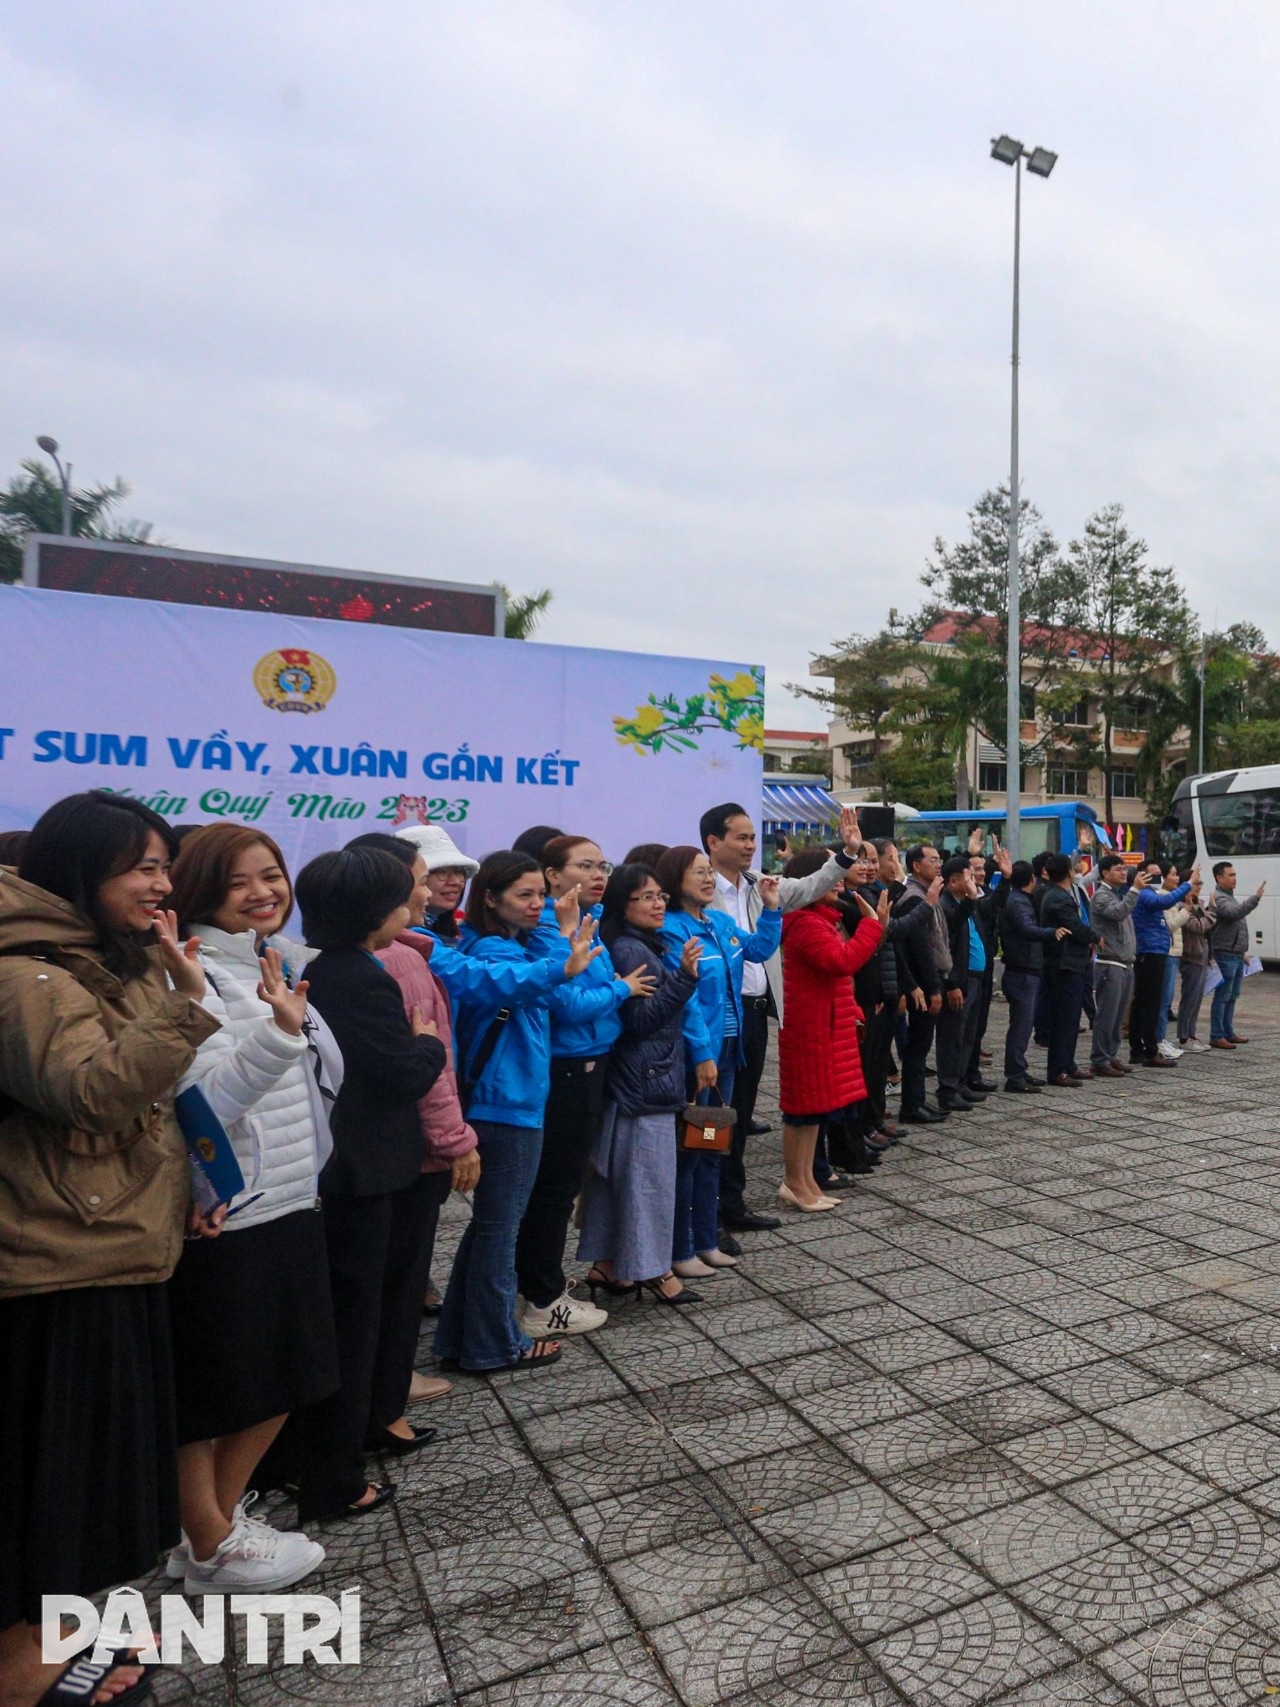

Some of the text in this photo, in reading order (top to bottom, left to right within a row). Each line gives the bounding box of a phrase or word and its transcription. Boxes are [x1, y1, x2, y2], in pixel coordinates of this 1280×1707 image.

[33, 730, 148, 767] SUM
[167, 729, 271, 776] VẦY,
[289, 741, 408, 779] XUÂN
[422, 743, 503, 783] GẮN
[516, 749, 580, 786] KẾT
